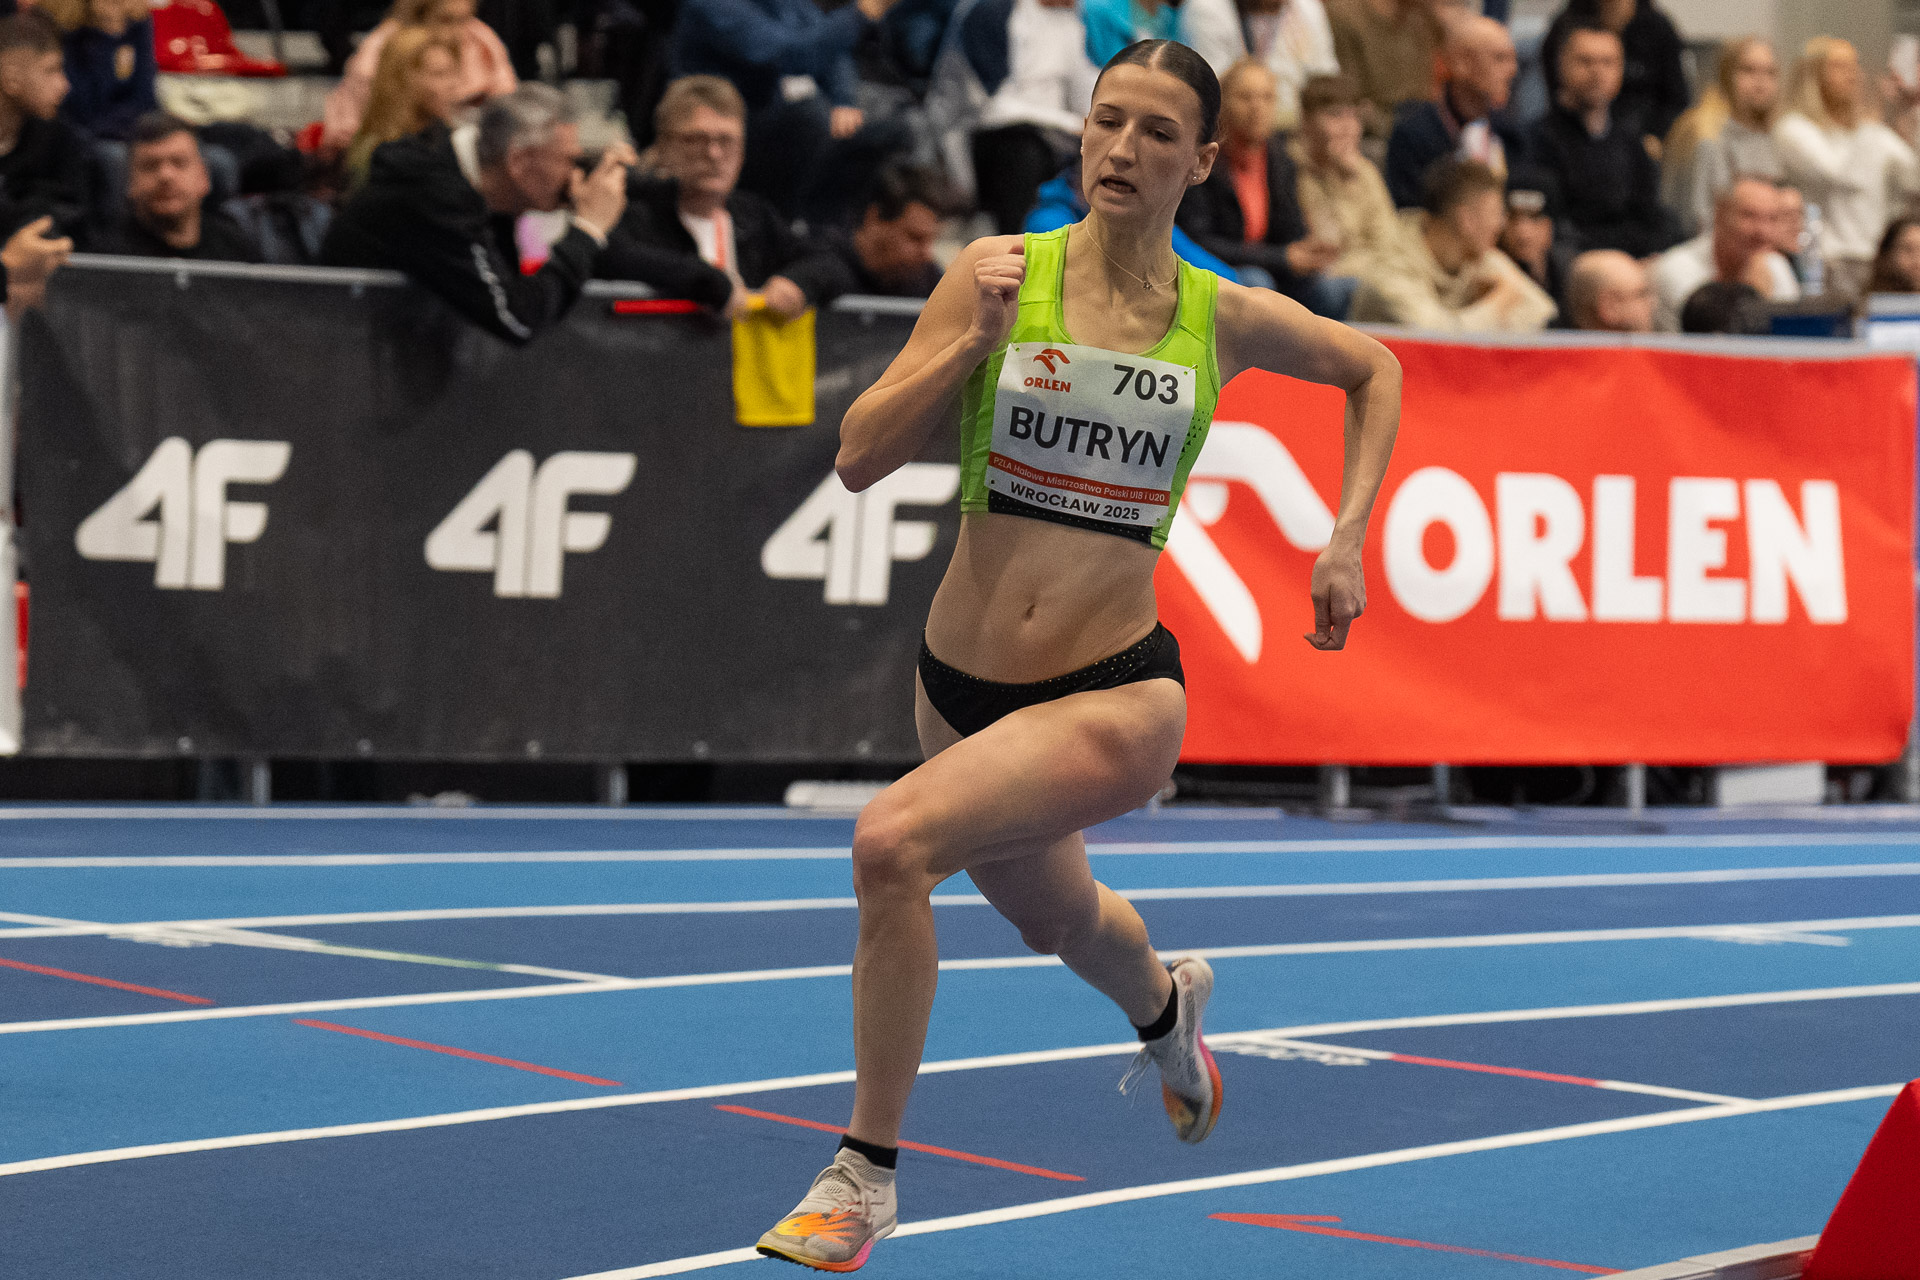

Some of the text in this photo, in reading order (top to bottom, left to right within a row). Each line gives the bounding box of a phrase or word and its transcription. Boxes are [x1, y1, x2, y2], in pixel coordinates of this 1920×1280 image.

[1024, 376, 1071, 393] ORLEN
[1113, 364, 1178, 405] 703
[1009, 405, 1171, 467] BUTRYN
[993, 457, 1012, 471] PZLA
[1014, 466, 1045, 482] Halowe
[1046, 476, 1102, 494] Mistrzostwa
[1103, 487, 1129, 499] Polski
[1130, 490, 1143, 500] U18
[1149, 492, 1165, 502] U20
[1010, 481, 1140, 520] WROCŁAW 2025
[75, 436, 293, 590] 4F
[424, 449, 637, 599] 4F
[761, 463, 960, 606] 4F
[1383, 465, 1848, 625] ORLEN
